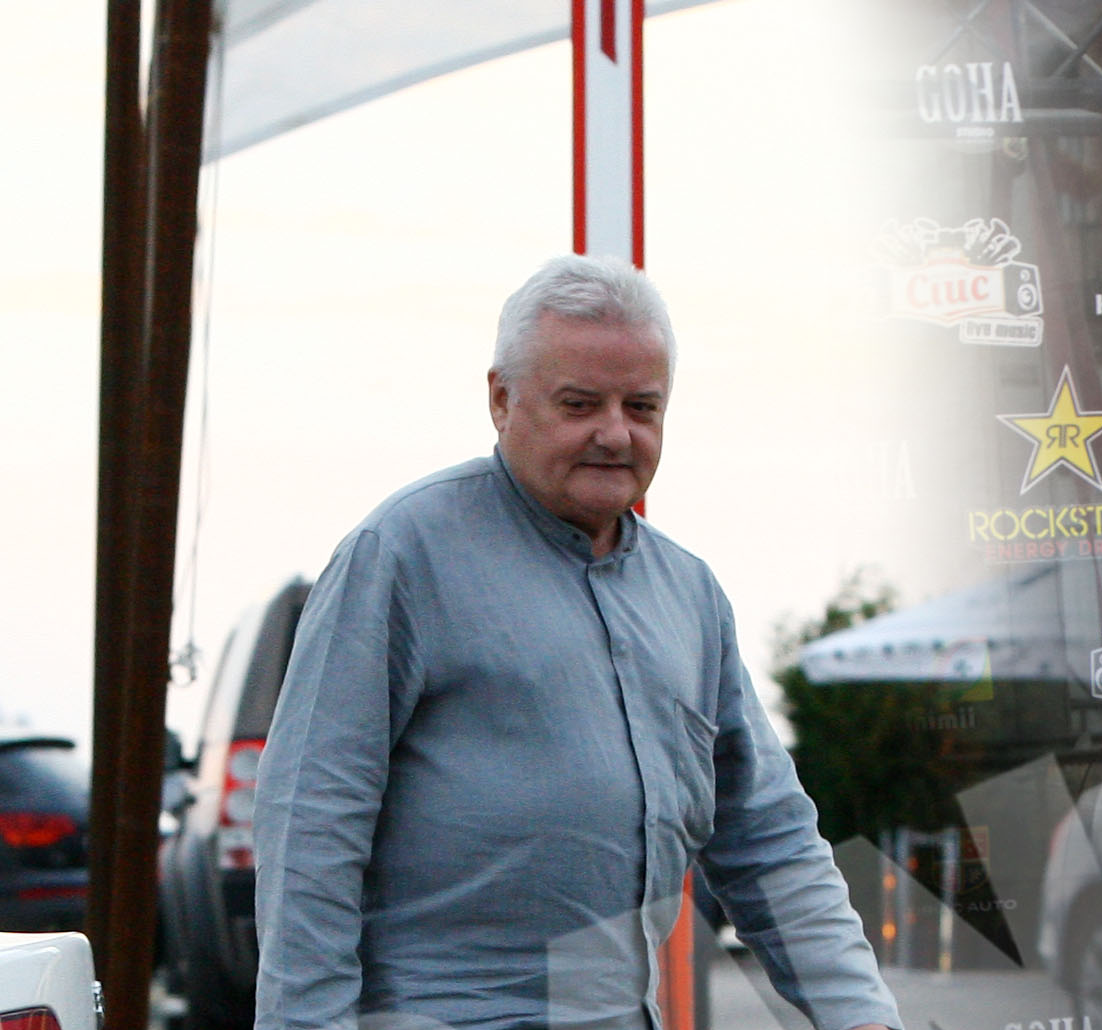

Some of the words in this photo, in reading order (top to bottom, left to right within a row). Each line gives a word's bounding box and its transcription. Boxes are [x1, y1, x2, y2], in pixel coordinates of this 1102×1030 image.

[916, 61, 1024, 123] GOHA
[906, 273, 990, 309] Ciuc
[986, 541, 1067, 561] ENERGY
